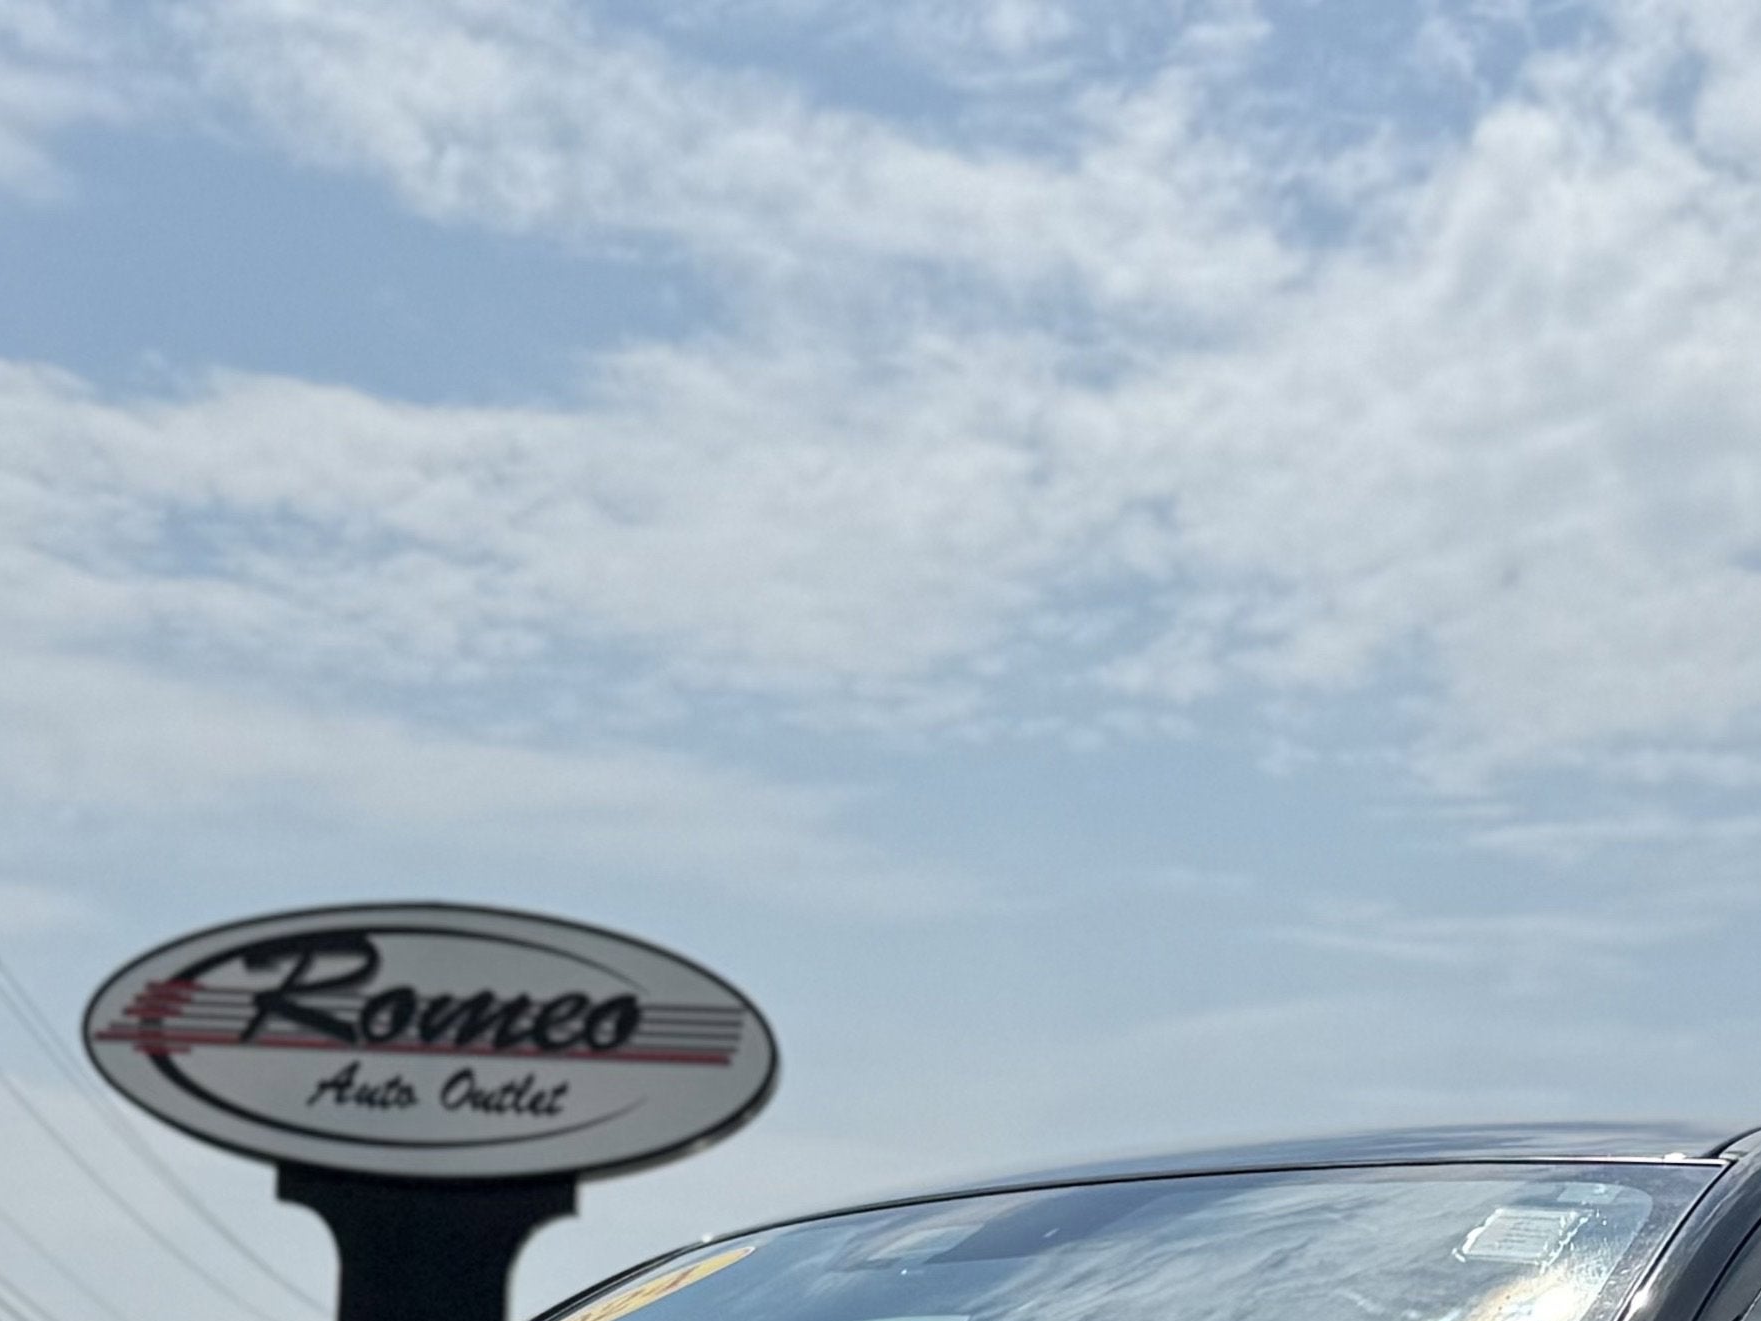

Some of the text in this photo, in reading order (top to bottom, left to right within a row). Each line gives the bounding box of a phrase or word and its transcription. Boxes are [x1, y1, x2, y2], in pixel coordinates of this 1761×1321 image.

[238, 930, 641, 1051] Romeo
[305, 1060, 569, 1118] Auto Outlet
